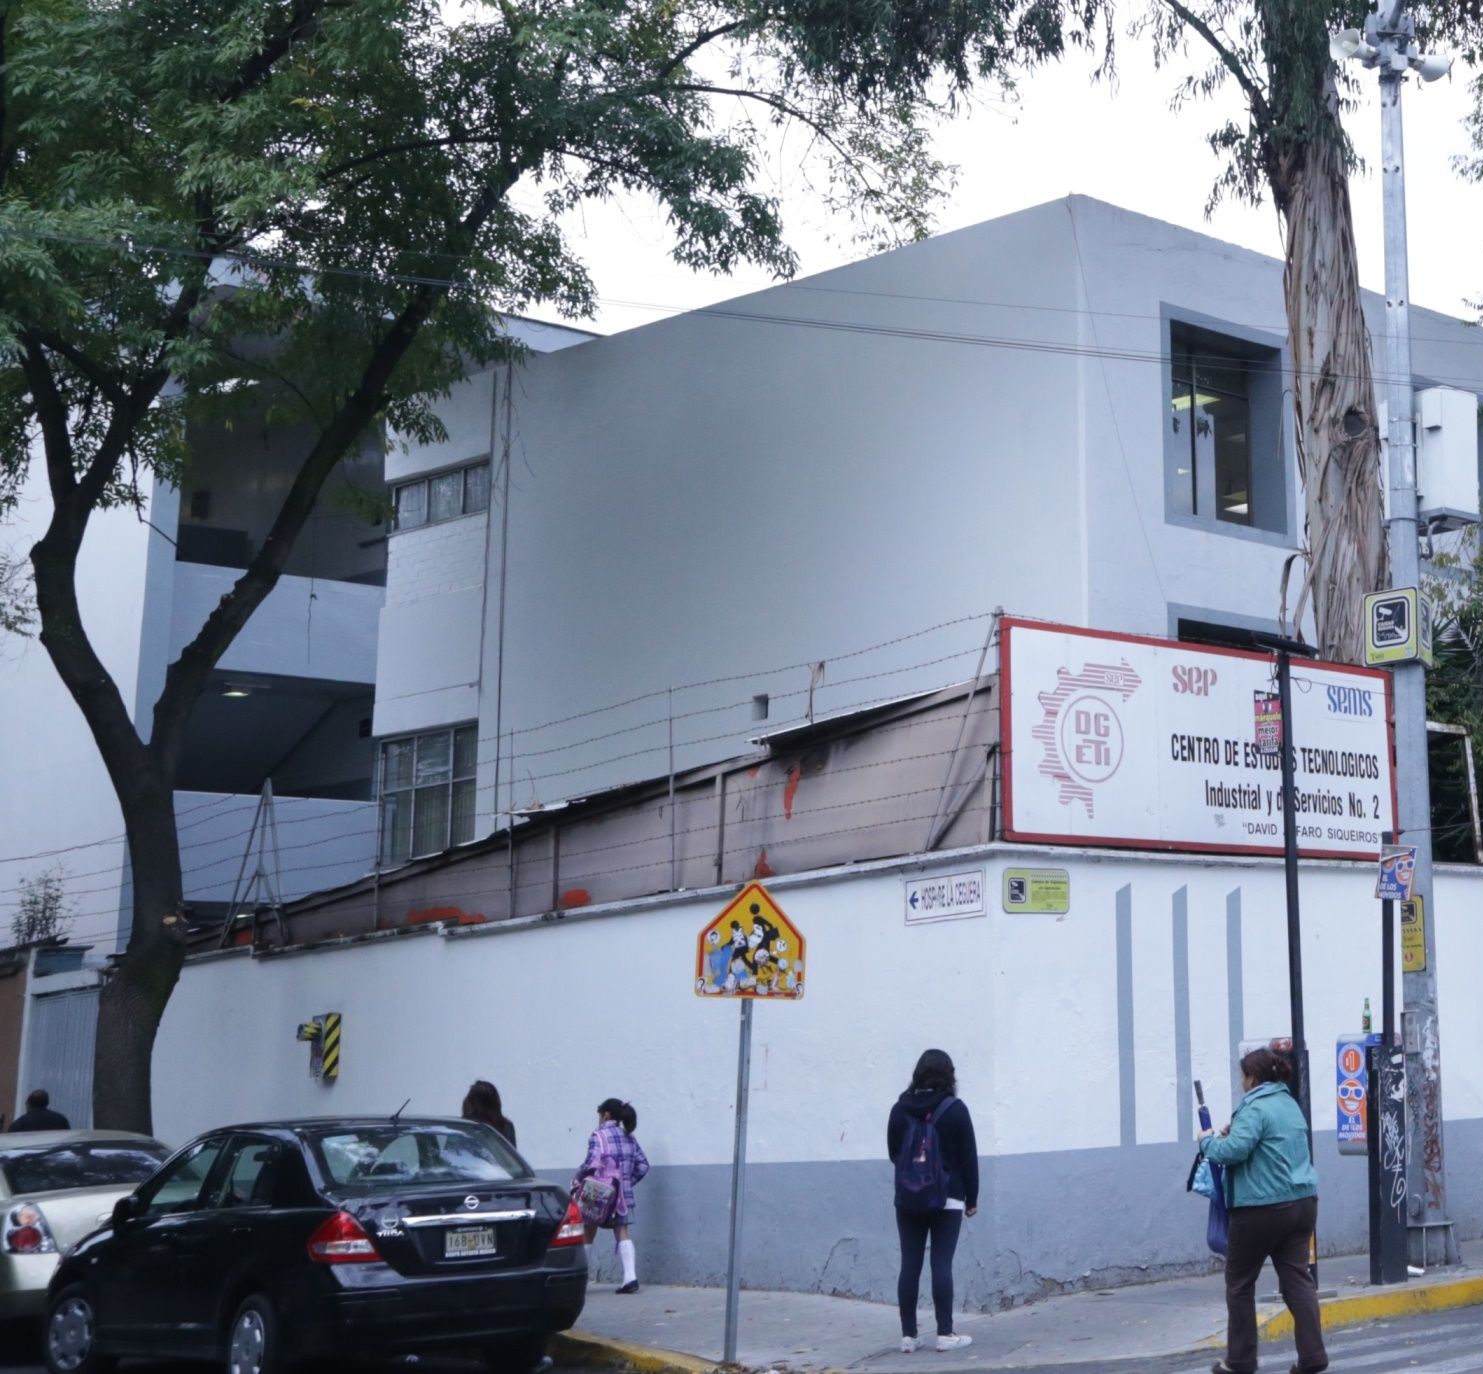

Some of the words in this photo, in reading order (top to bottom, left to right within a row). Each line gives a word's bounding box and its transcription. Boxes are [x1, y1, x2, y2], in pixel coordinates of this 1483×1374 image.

[1075, 710, 1110, 738] DG
[1258, 726, 1278, 736] mejor
[1259, 735, 1279, 746] tarifa
[1171, 733, 1220, 765] CENTRO
[1224, 739, 1239, 767] DE
[1301, 747, 1379, 780] TECNOLOGICOS
[1205, 779, 1261, 811] Industrial
[1266, 790, 1273, 816] y
[1294, 786, 1343, 816] Servicios
[1349, 792, 1366, 819] No.
[1373, 795, 1380, 820] 2
[955, 880, 980, 906] CEGUERA
[1387, 883, 1397, 891] LOS
